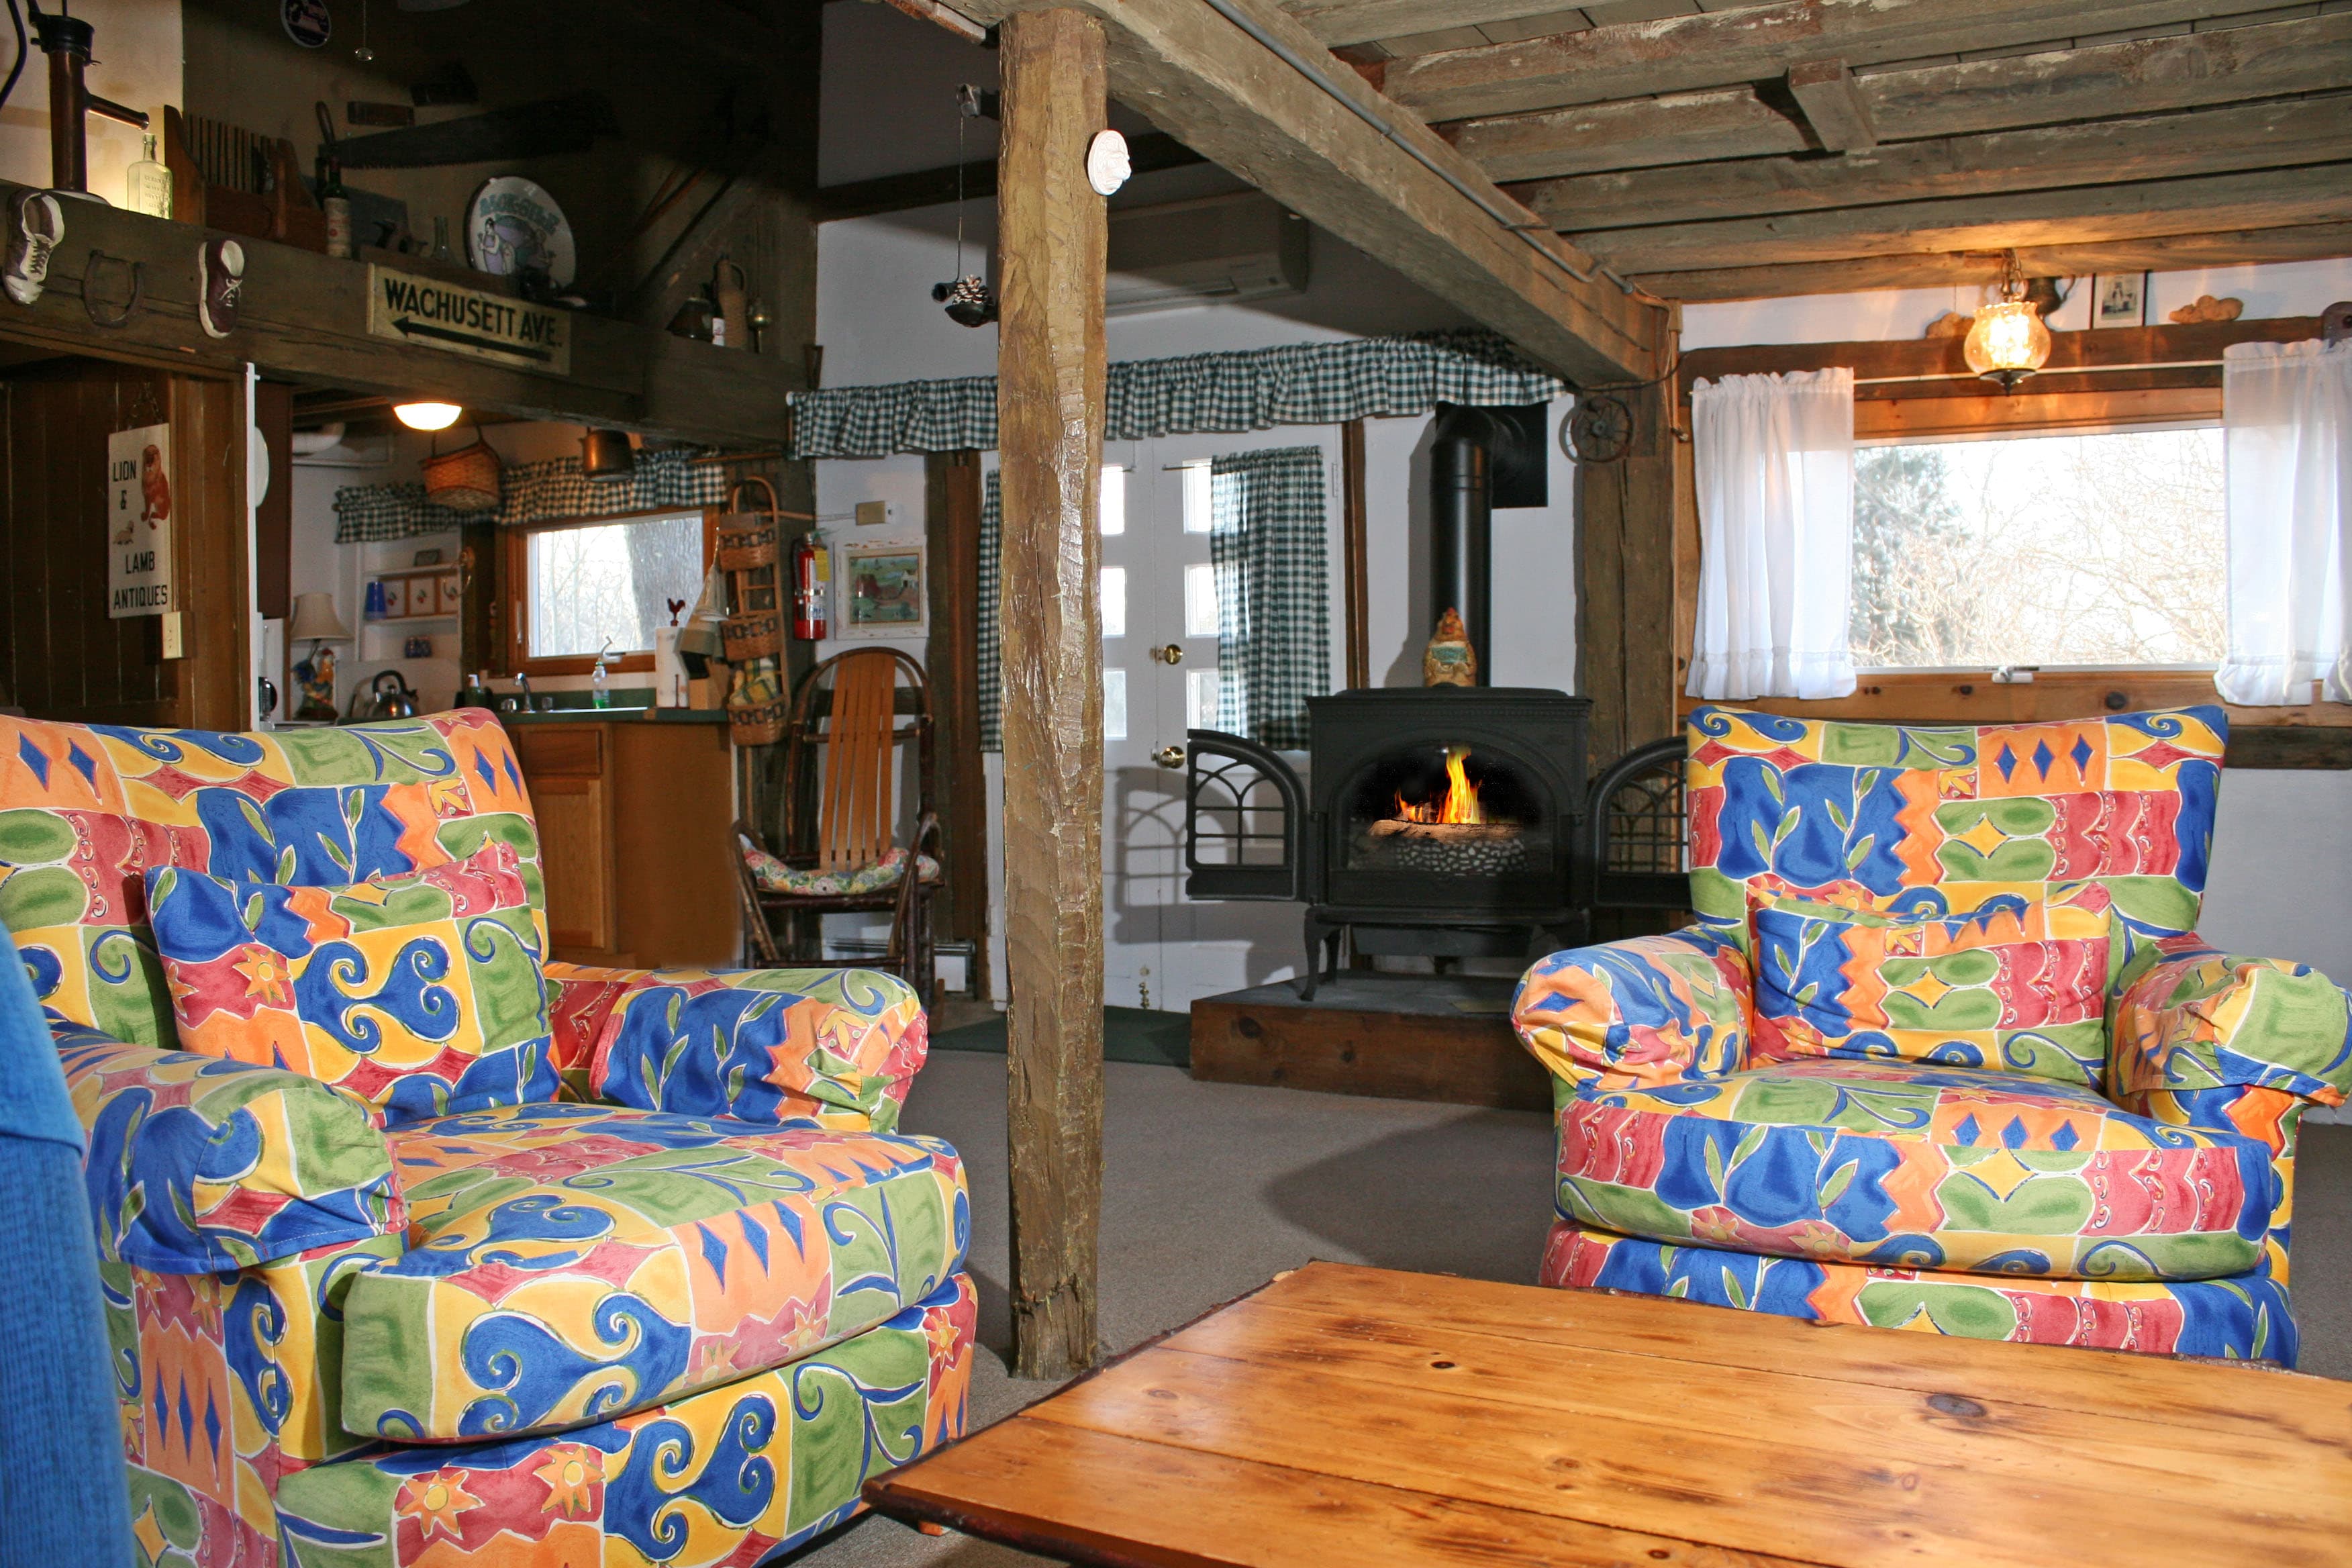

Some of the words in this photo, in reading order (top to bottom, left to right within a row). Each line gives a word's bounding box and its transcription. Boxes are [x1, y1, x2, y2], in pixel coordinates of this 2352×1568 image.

[385, 278, 516, 337] WACHUSETT
[519, 311, 563, 347] AVE.
[113, 460, 136, 482] LION
[120, 490, 127, 510] &
[126, 551, 155, 575] LAMB
[113, 585, 168, 610] ANTIQUES
